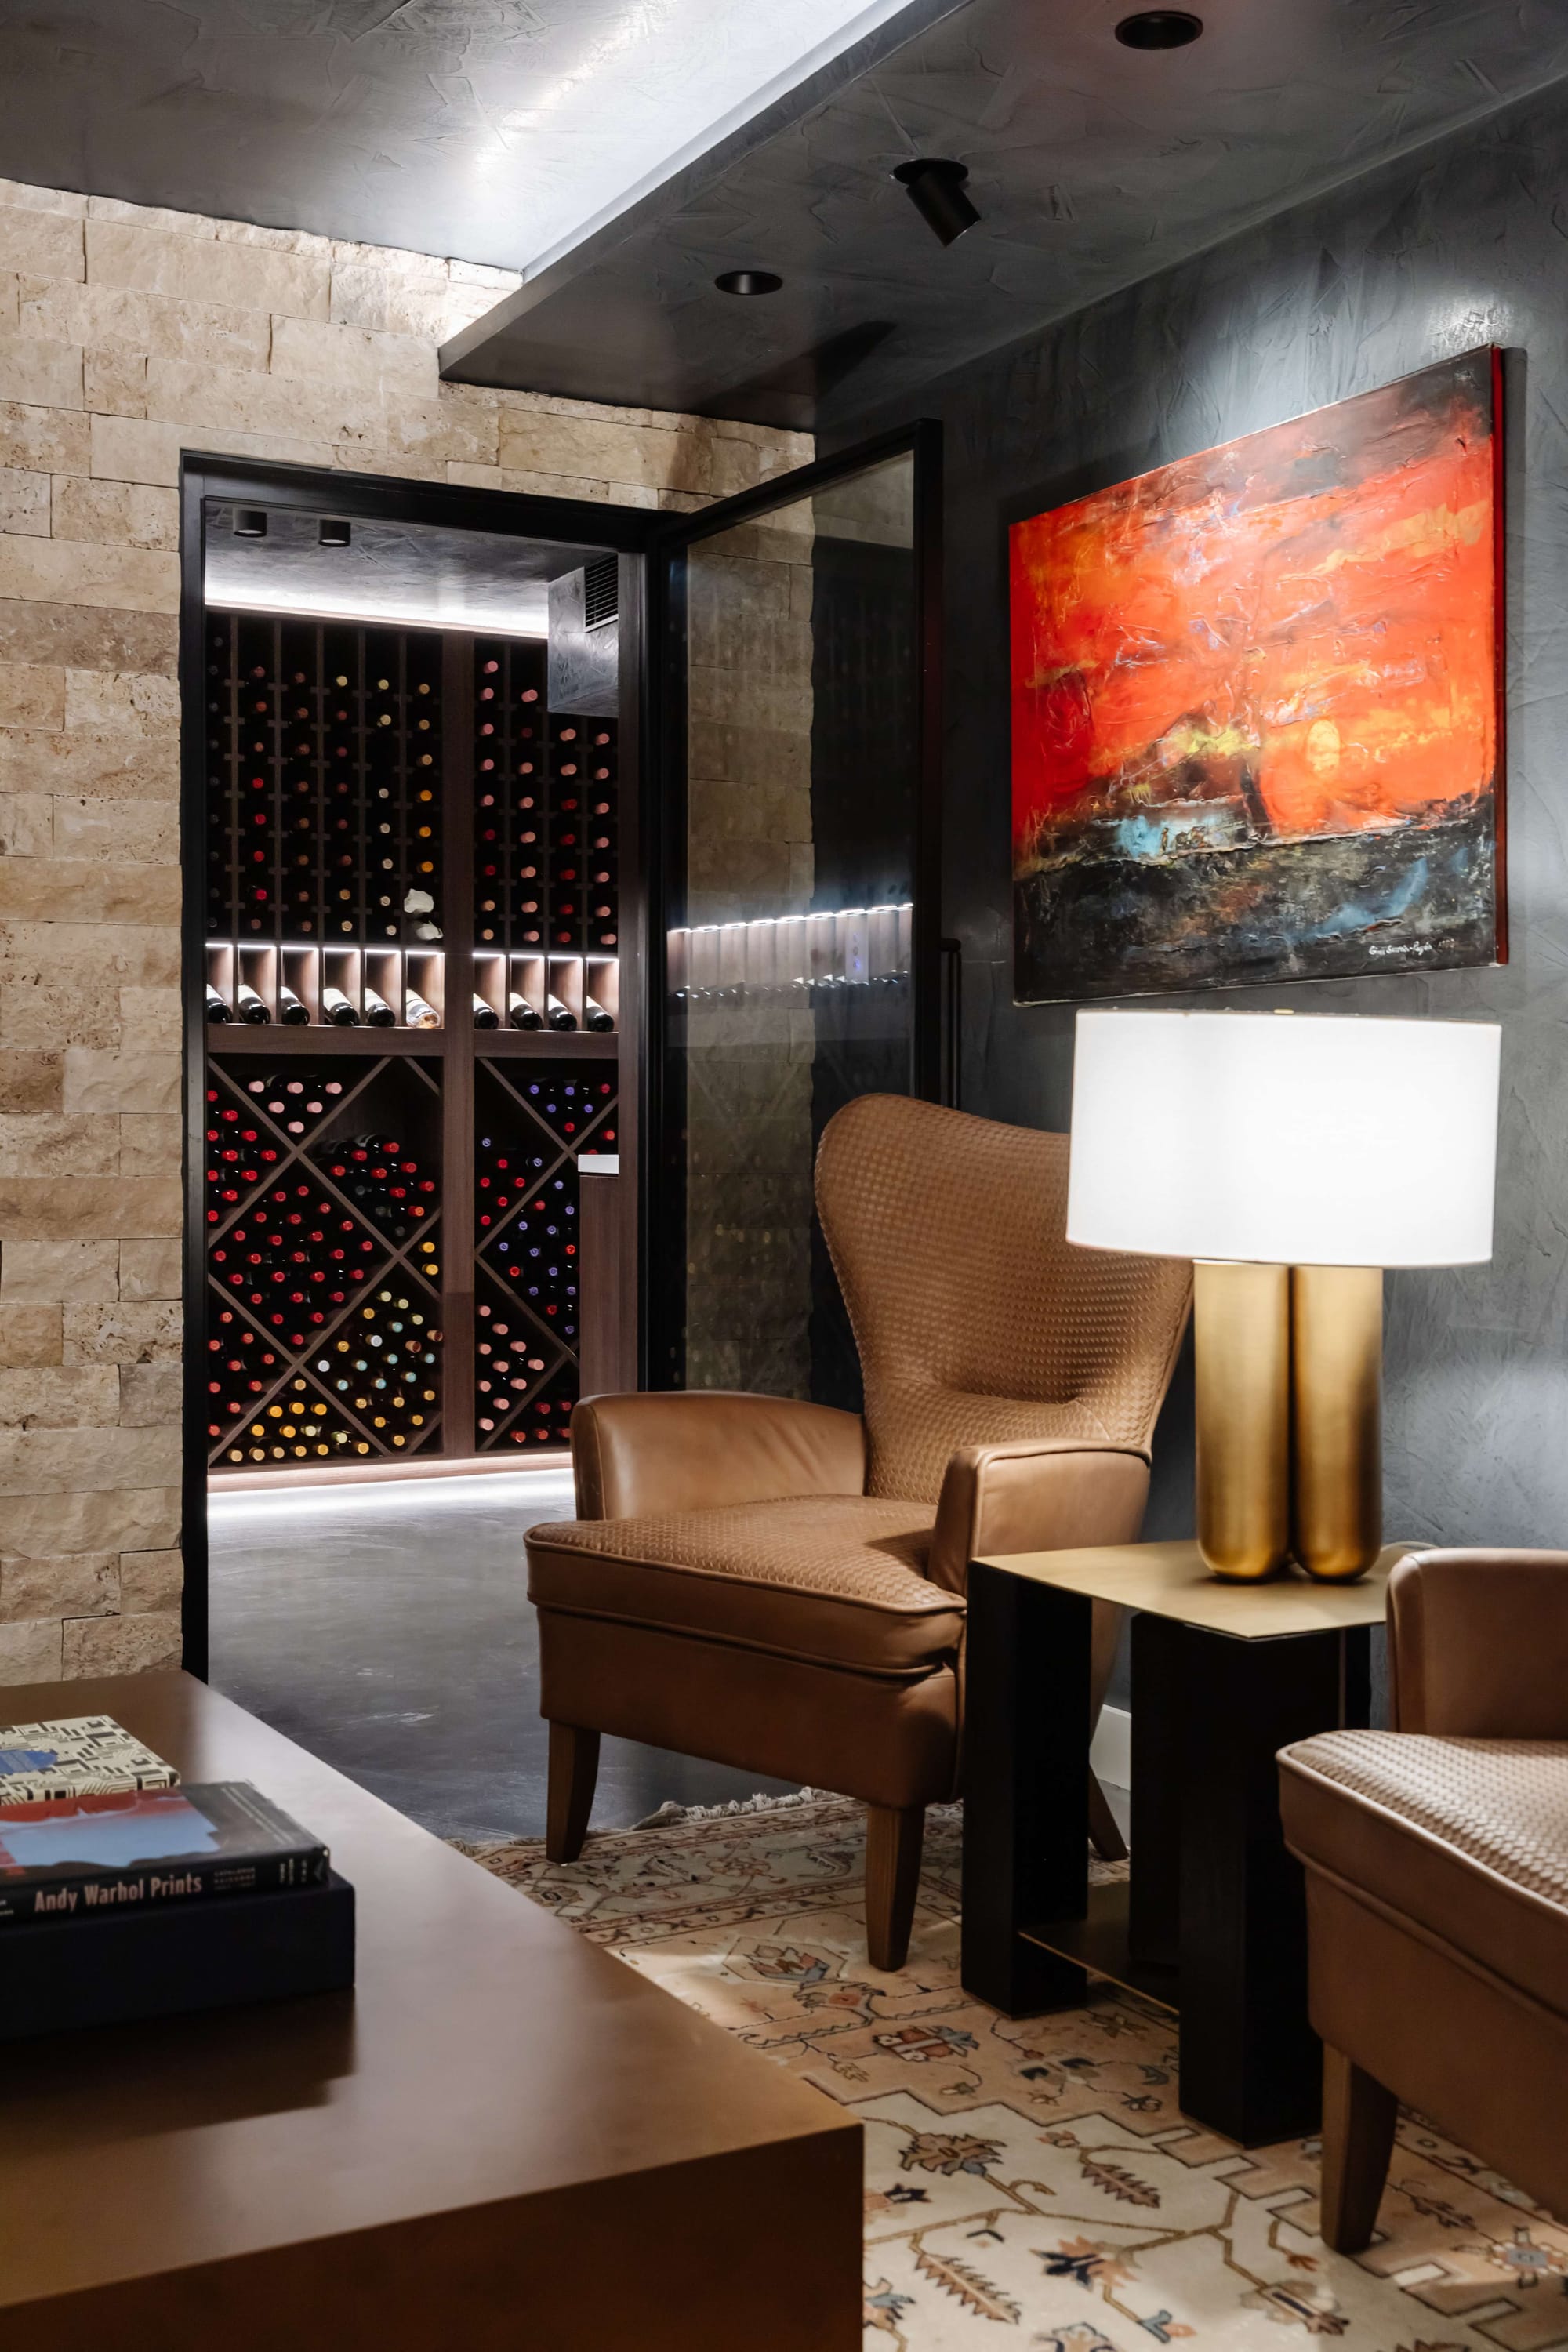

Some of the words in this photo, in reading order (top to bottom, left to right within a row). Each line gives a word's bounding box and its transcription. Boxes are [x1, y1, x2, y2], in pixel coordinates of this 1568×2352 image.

[34, 1888, 77, 1913] Andy
[84, 1878, 143, 1905] Warhol
[151, 1872, 202, 1897] Prints
